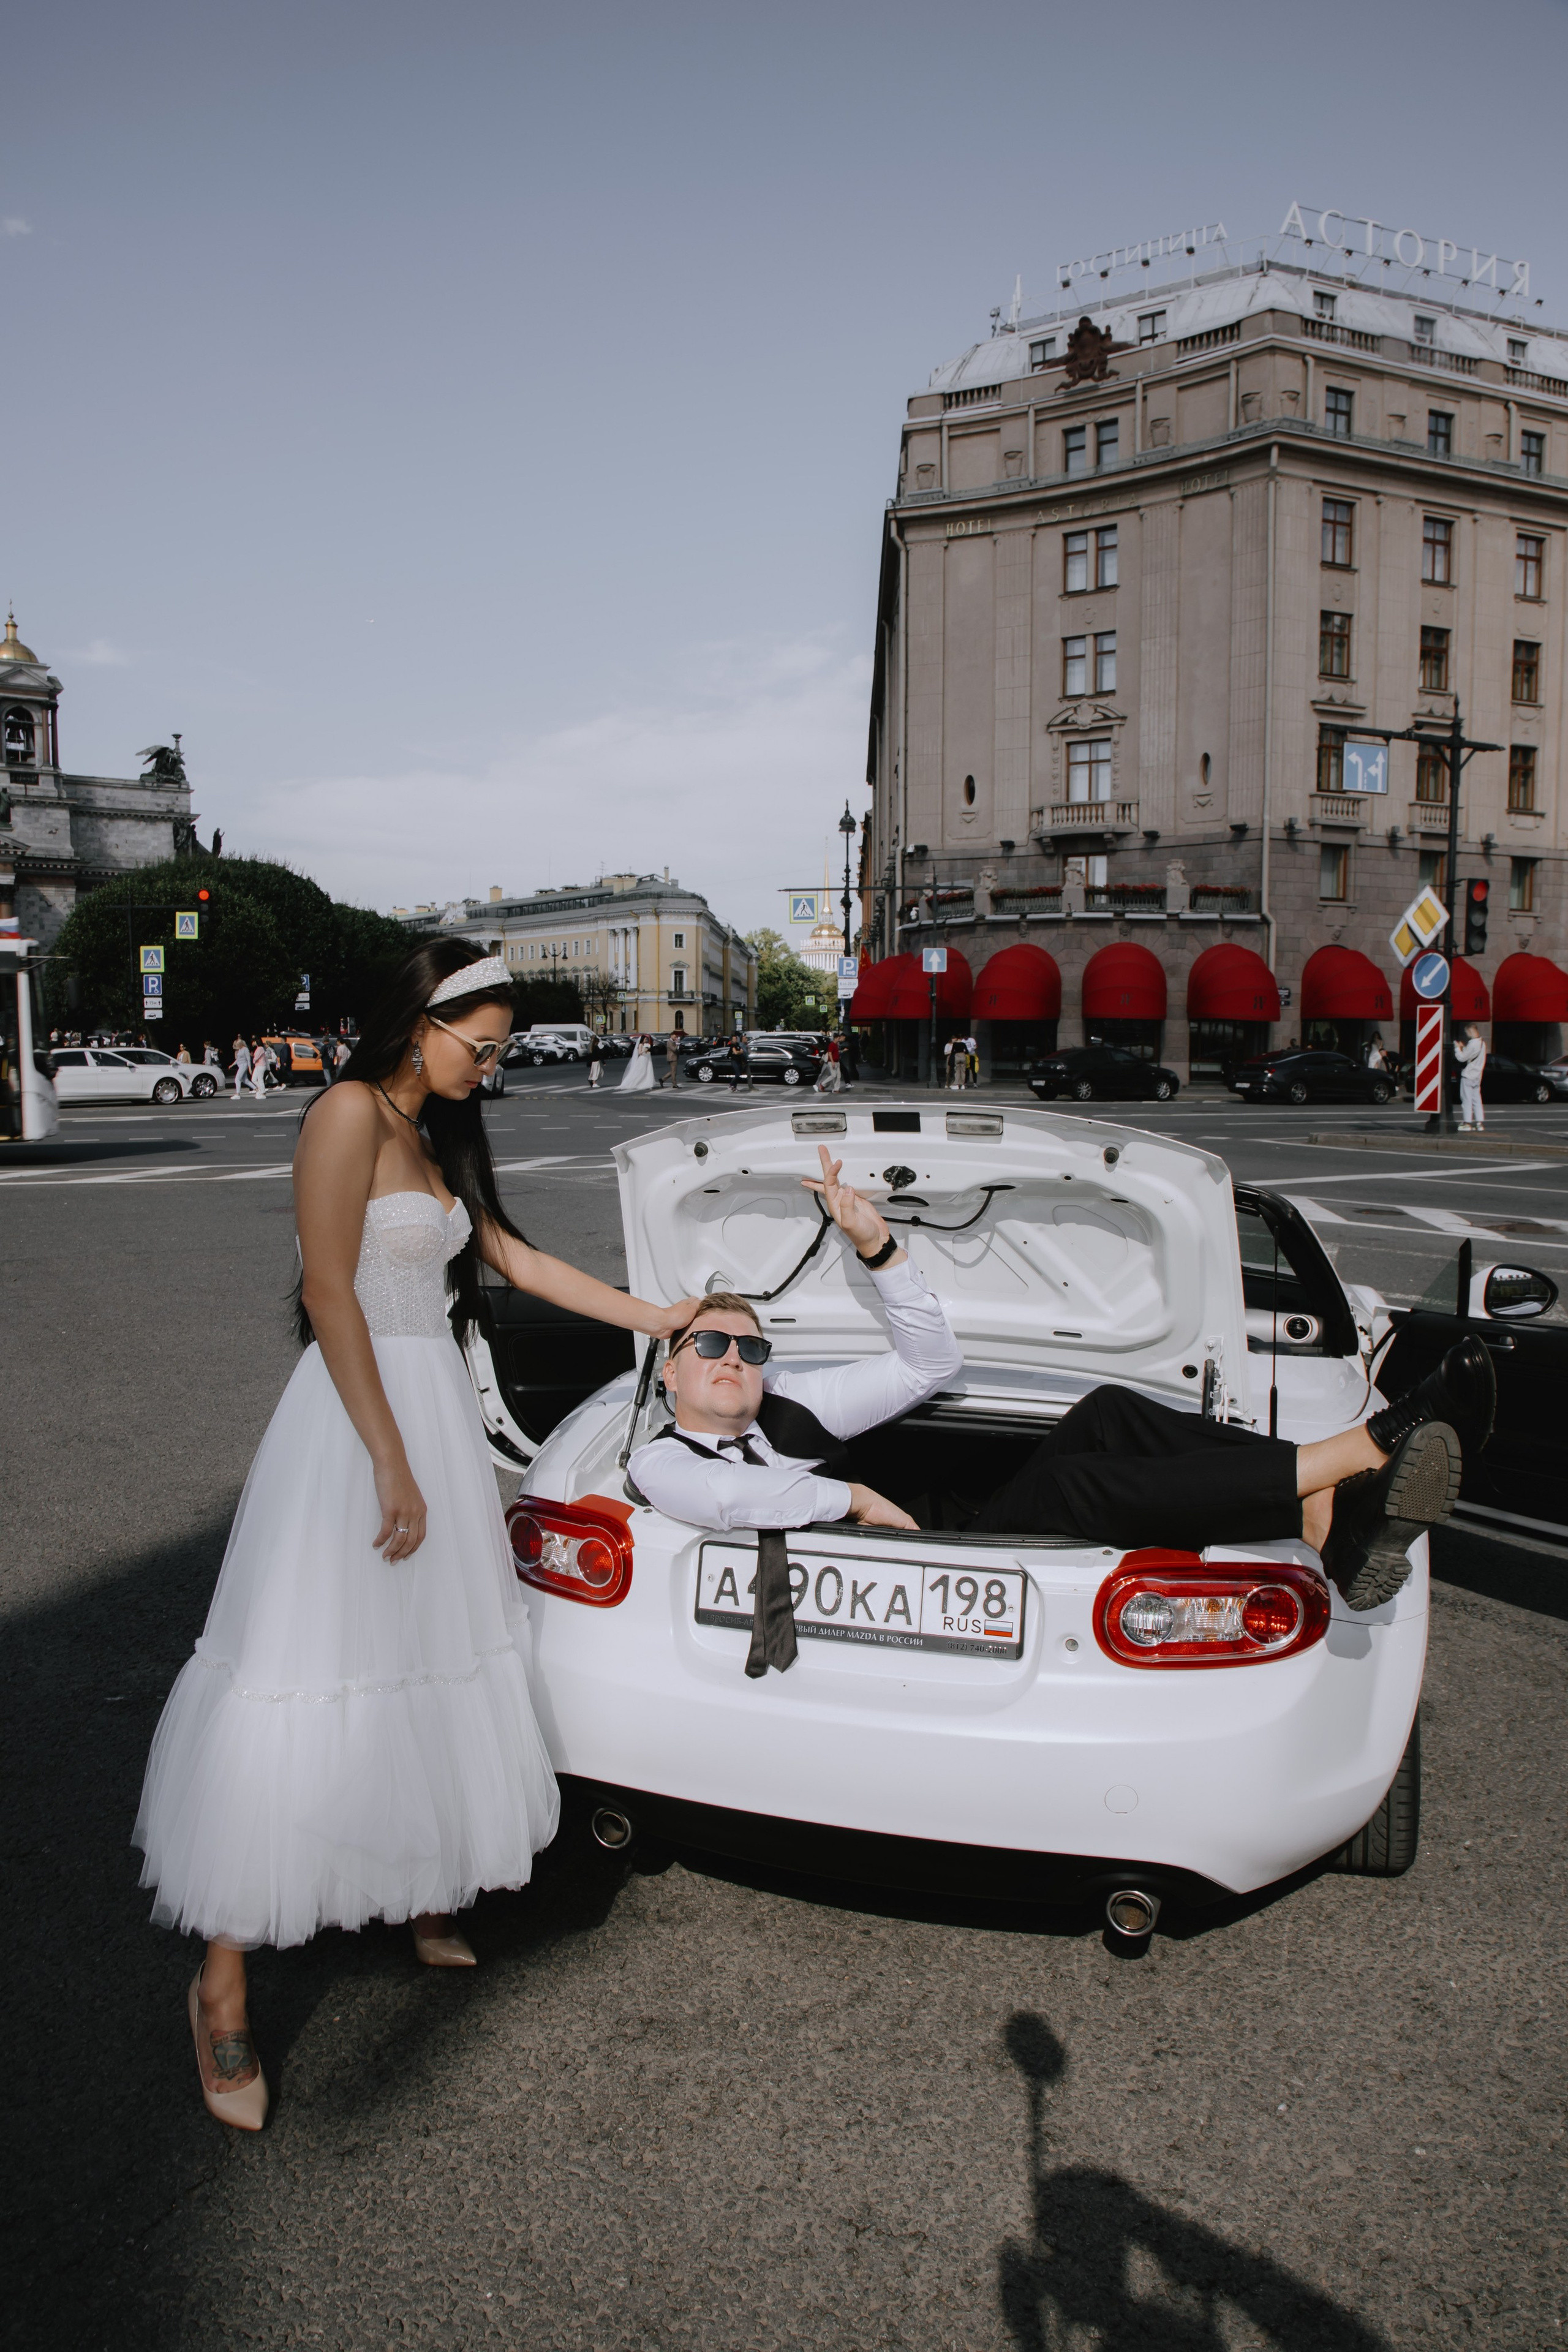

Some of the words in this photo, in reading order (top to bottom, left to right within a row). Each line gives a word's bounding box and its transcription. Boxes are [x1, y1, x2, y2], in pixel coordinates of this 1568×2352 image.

[1057, 222, 1227, 283] ГОСТИНИЦА
[1280, 200, 1529, 297] АСТОРИЯ
[1181, 470, 1229, 495] HOTEL
[946, 518, 992, 537] HOTEL
[1036, 494, 1137, 524] ASTORIA
[929, 1574, 1006, 1618] 198
[818, 1628, 845, 1638] ДИЛЕР
[847, 1631, 877, 1641] MAZDA
[887, 1635, 923, 1646] РОССИИ
[948, 1642, 968, 1651] (812)
[943, 1616, 981, 1634] RUS
